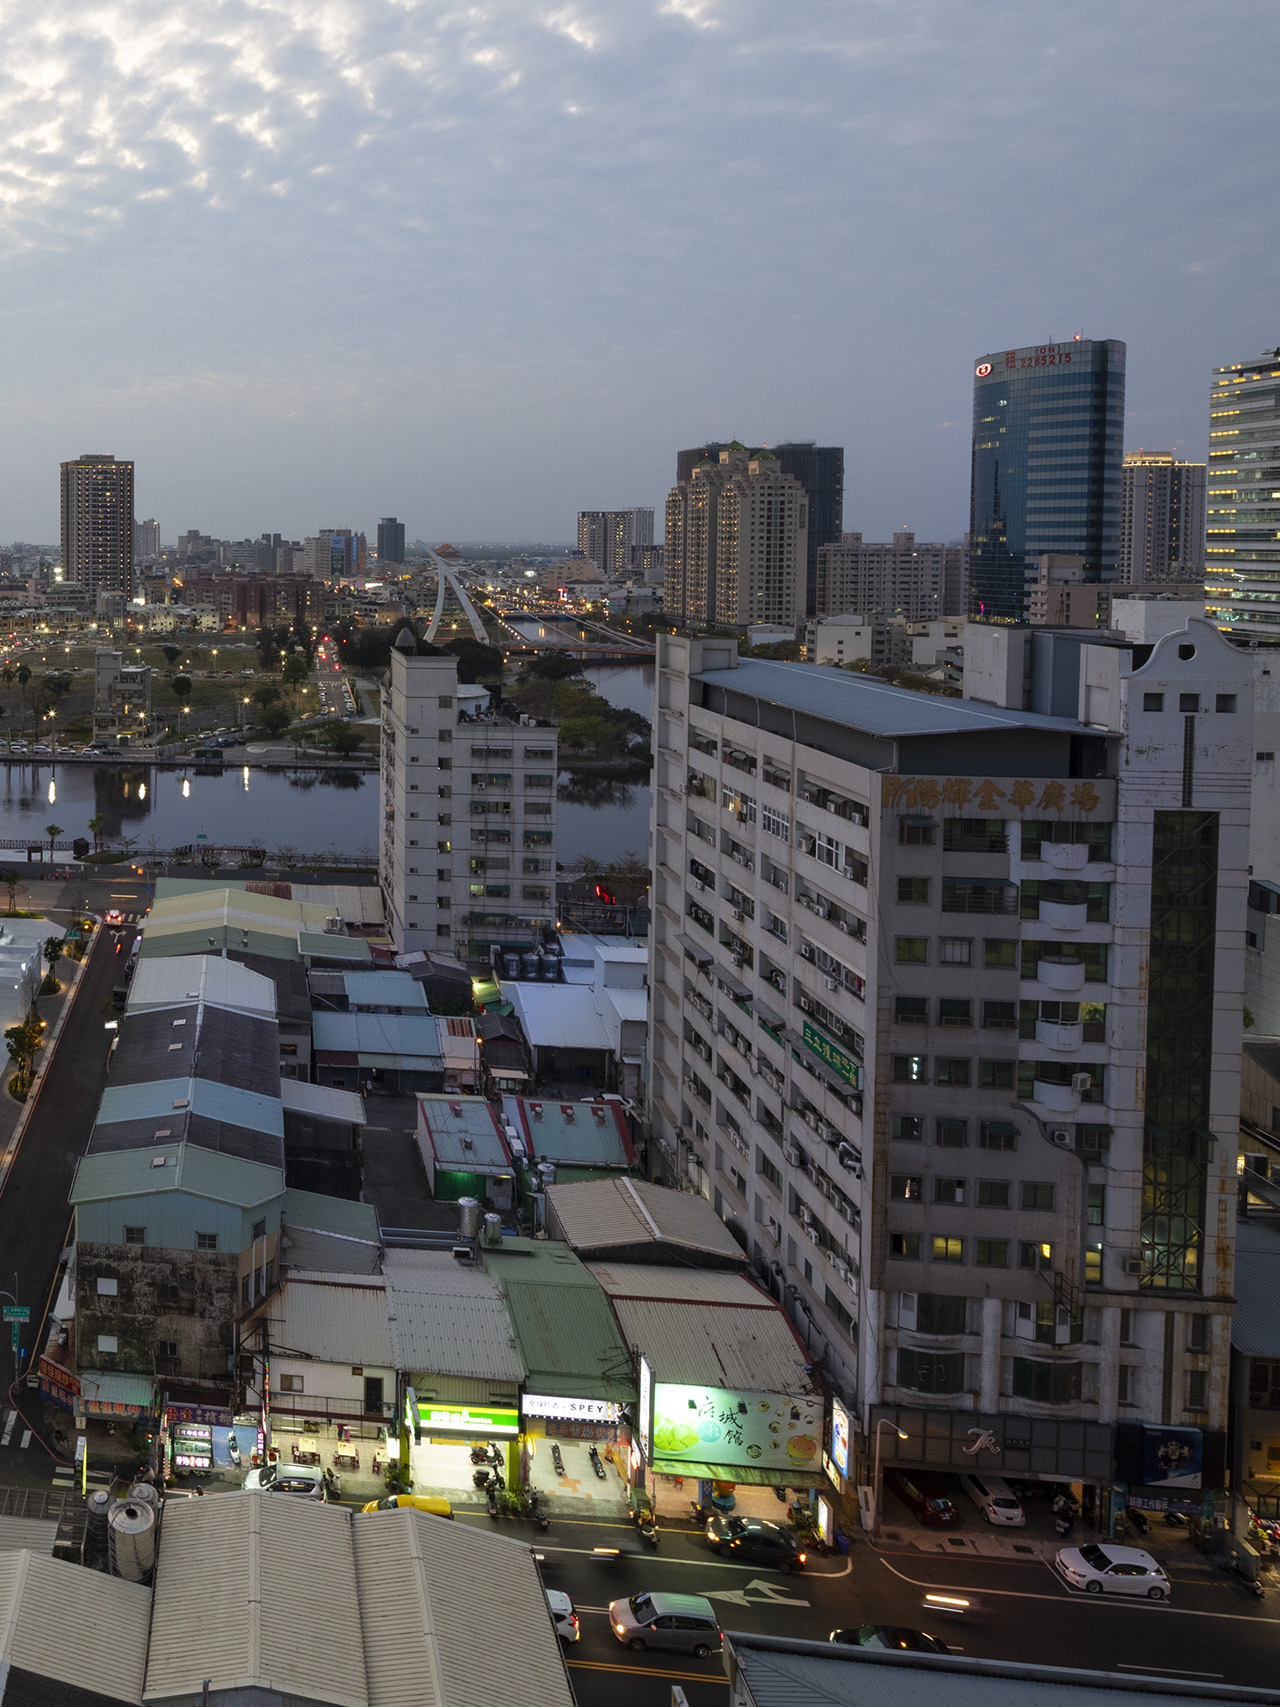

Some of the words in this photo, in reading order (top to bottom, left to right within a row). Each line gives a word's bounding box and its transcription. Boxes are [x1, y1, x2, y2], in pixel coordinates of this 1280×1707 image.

[1035, 344, 1061, 356] (06)
[1005, 351, 1017, 369] 租
[1020, 352, 1072, 369] 2285215
[570, 1403, 604, 1413] SPEY
